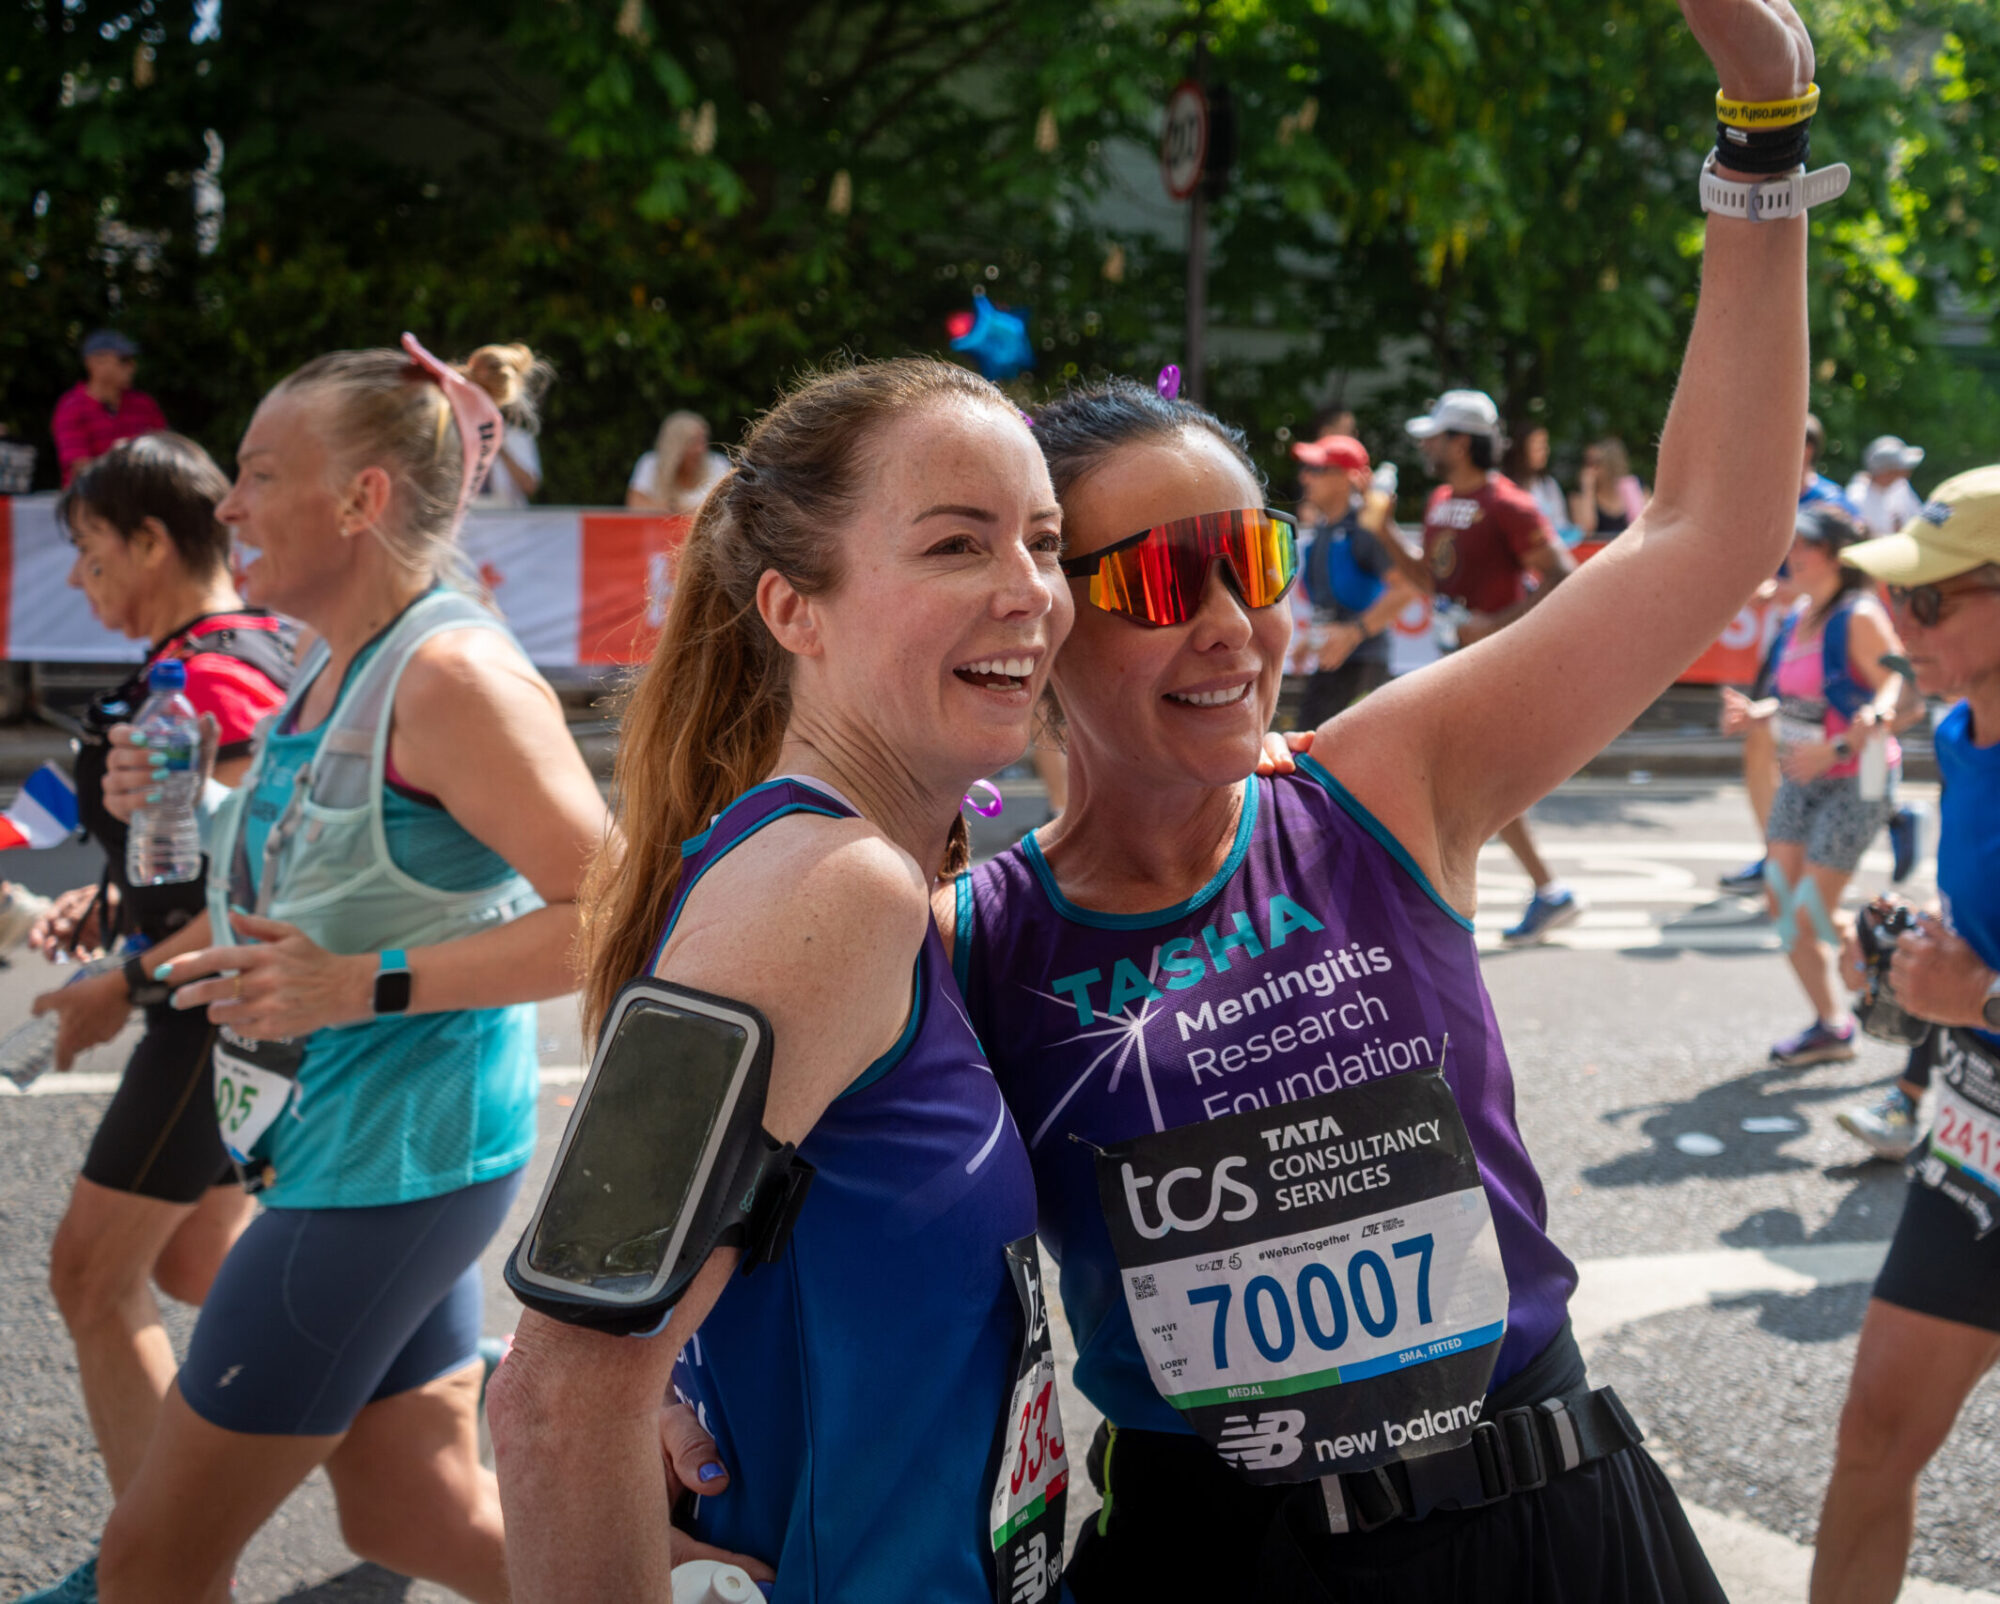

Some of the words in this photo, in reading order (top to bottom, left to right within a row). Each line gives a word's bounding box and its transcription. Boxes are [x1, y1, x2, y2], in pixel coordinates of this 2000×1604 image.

[1051, 894, 1324, 1027] TASHA
[1175, 942, 1392, 1041] Meningitis
[1187, 990, 1390, 1085] Research
[1261, 1116, 1343, 1151] TATA
[1268, 1119, 1441, 1181] CONSULTANCY
[1275, 1164, 1391, 1211] SERVICES
[1258, 1233, 1351, 1261] #WeRunTogether
[1187, 1232, 1435, 1371] 70007
[1152, 1323, 1178, 1335] WAVE
[1162, 1334, 1174, 1342] 13
[1160, 1358, 1188, 1371] LORRY
[1398, 1349, 1427, 1364] SMA,
[1428, 1337, 1463, 1356] FITTED
[1172, 1369, 1183, 1378] 32
[1227, 1385, 1265, 1399] MEDAL
[1314, 1429, 1378, 1462] new
[1383, 1393, 1487, 1448] balanc
